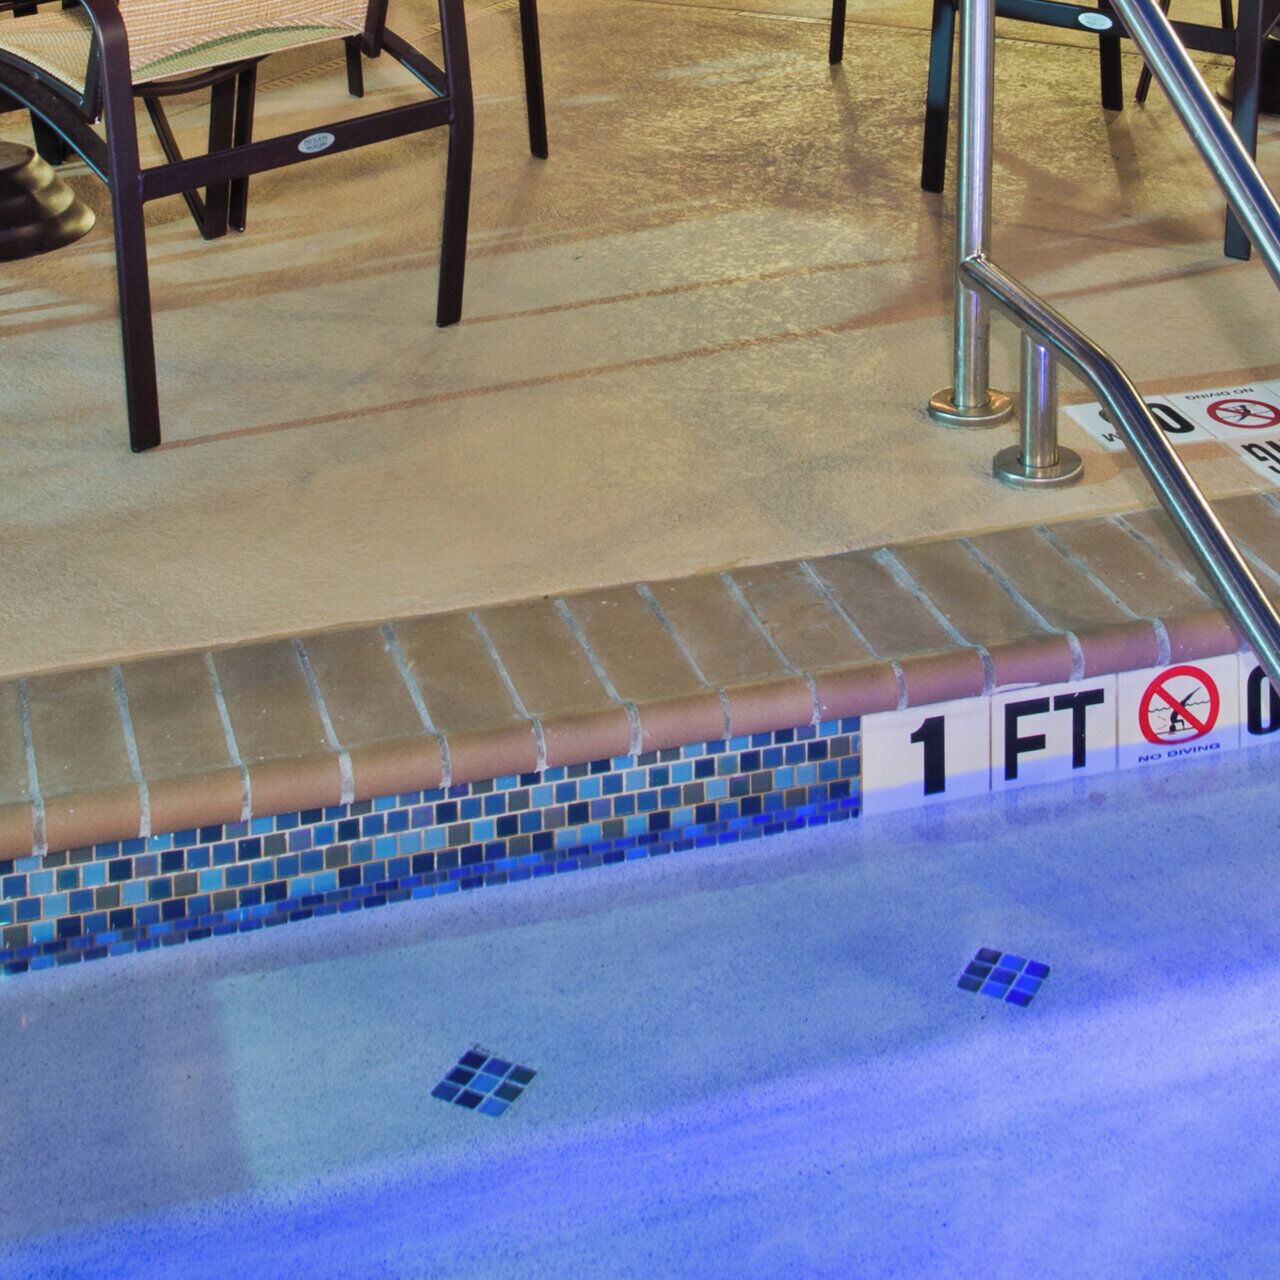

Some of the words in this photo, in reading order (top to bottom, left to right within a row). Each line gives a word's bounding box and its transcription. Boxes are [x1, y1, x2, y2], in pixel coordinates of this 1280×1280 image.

[1185, 391, 1231, 400] DIVING
[910, 715, 945, 796] 1
[1004, 688, 1105, 782] FT
[1138, 753, 1162, 763] NO
[1167, 742, 1221, 757] DIVING
